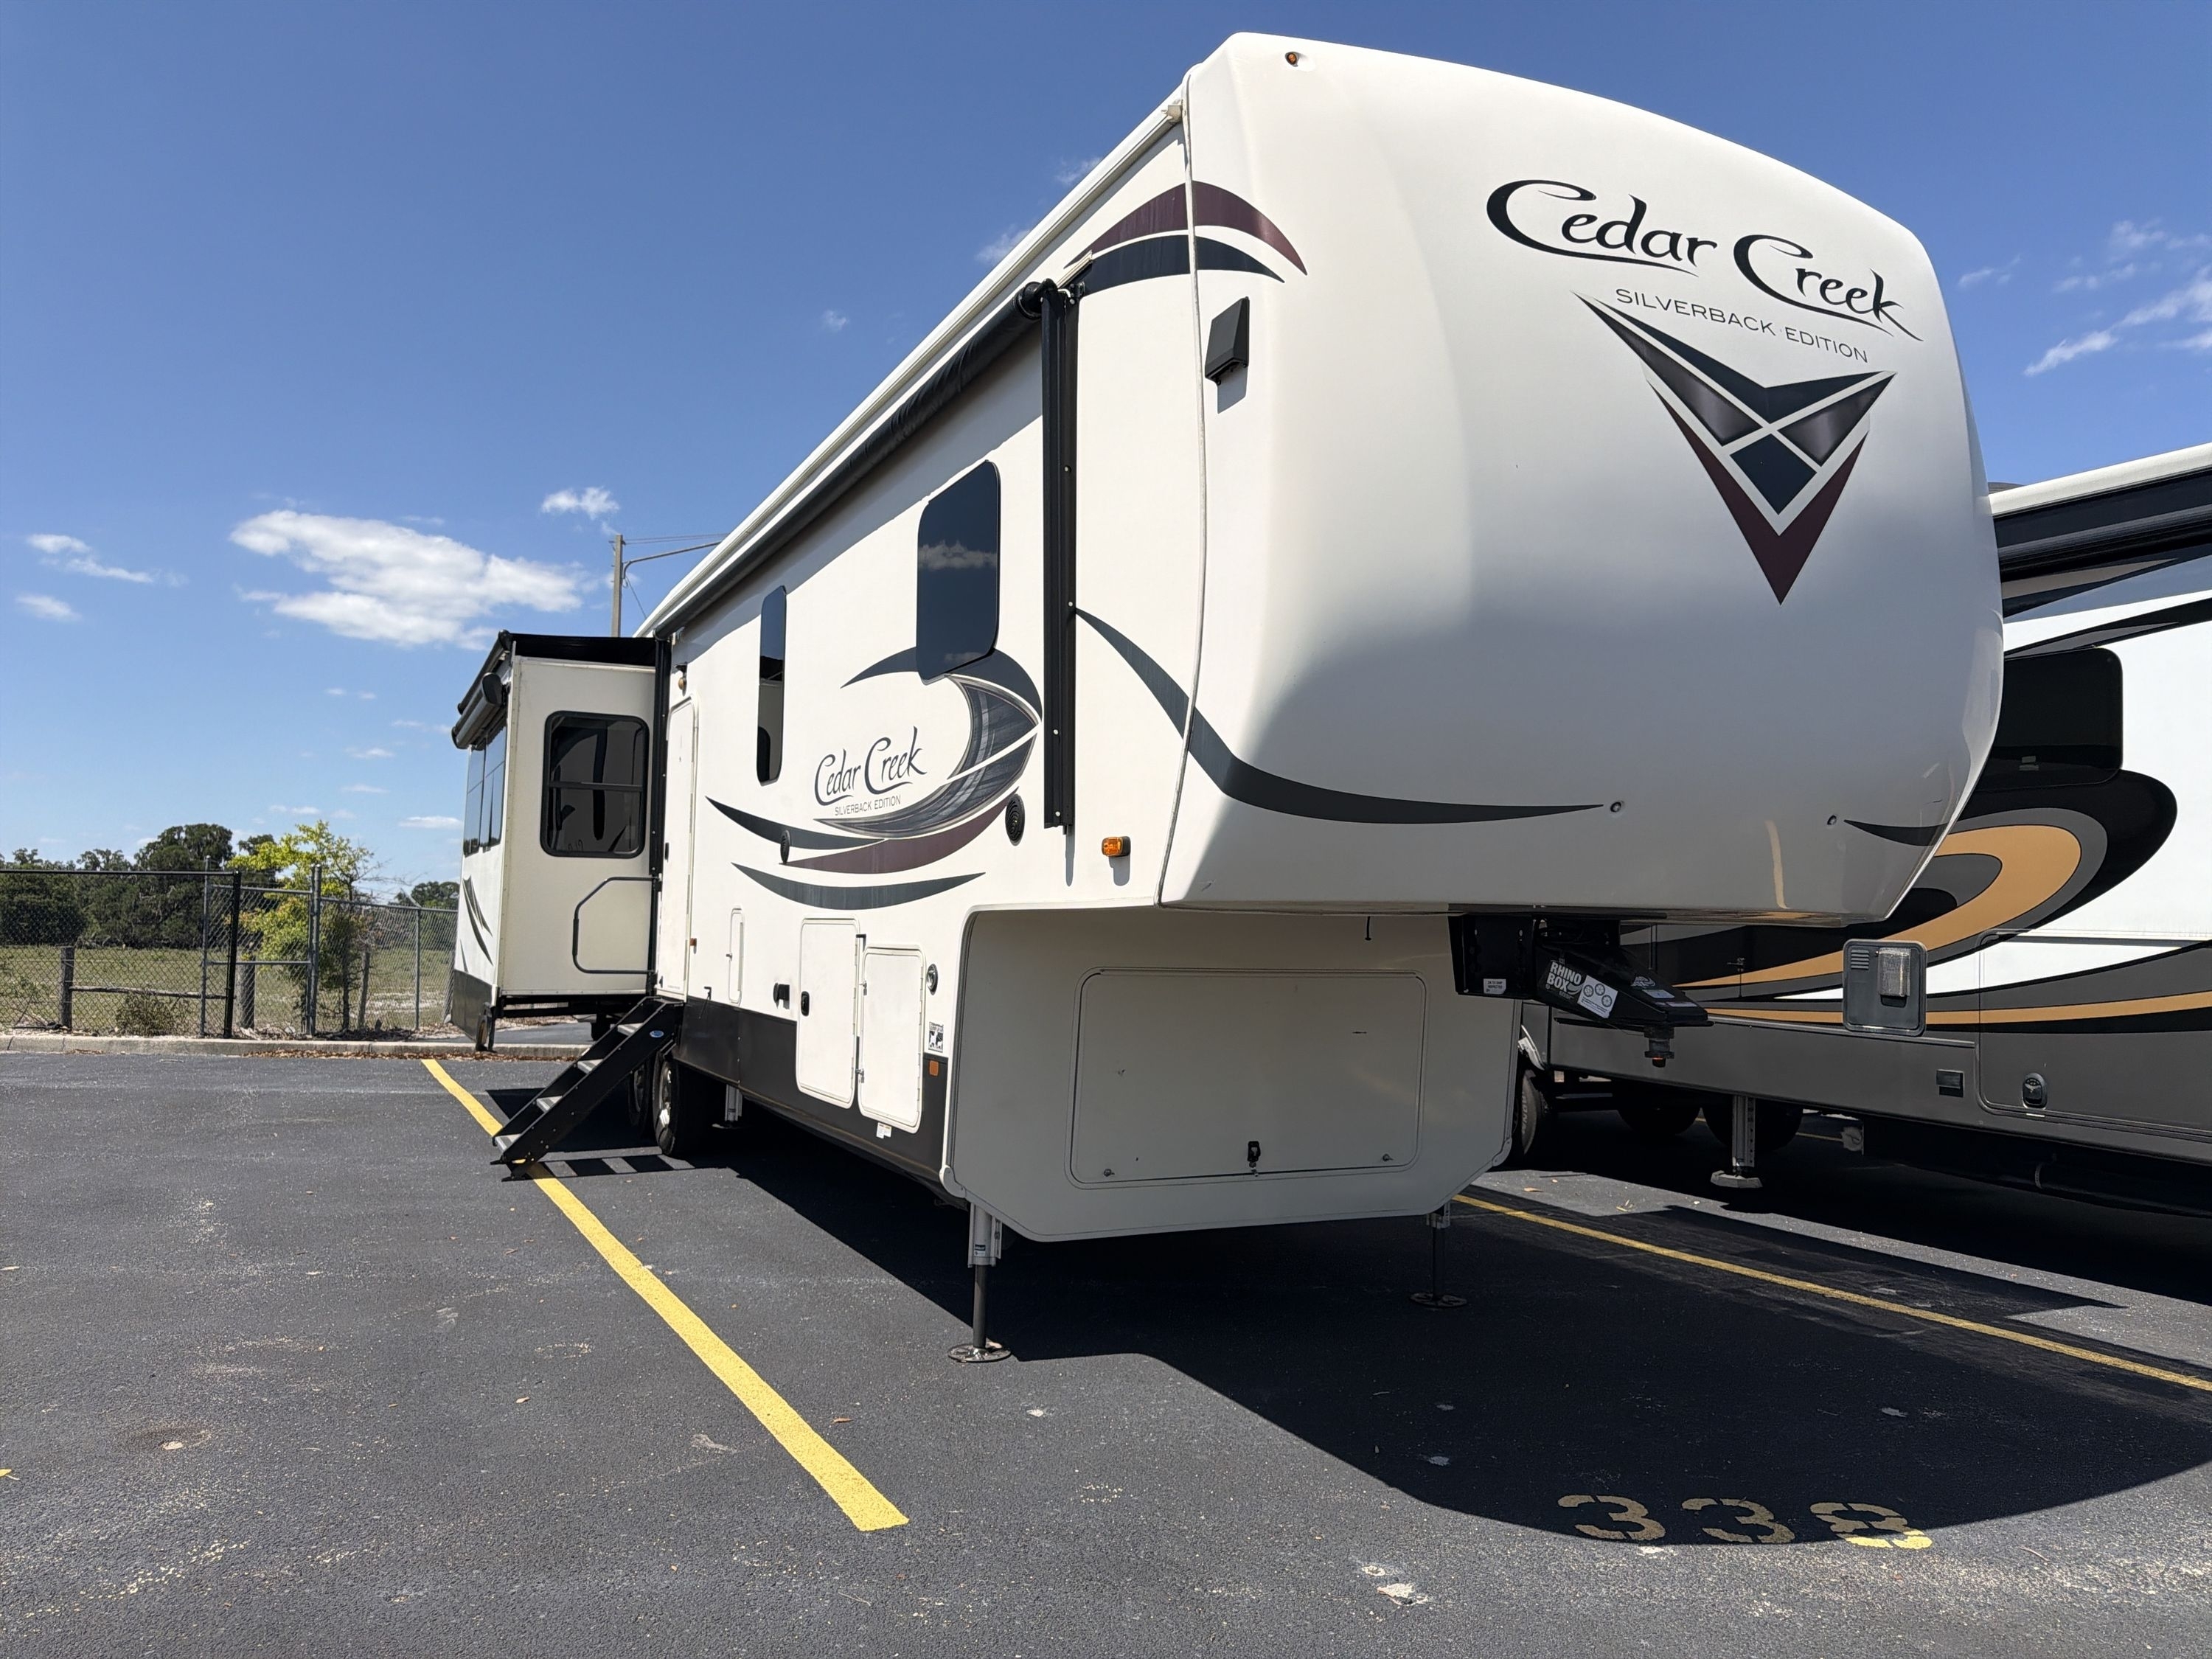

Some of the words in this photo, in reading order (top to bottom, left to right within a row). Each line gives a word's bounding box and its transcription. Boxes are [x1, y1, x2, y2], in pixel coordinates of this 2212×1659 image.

[1486, 179, 1718, 277] Cedar
[1733, 234, 1924, 342] Creek
[1615, 288, 1775, 336] SILVERBACK
[1785, 327, 1868, 364] EDITION
[814, 748, 861, 806] Cedar
[864, 725, 928, 795] Creek
[835, 801, 872, 816] SILVERBACK
[874, 794, 901, 810] EDITION
[1546, 972, 1570, 992] BOX
[1550, 961, 1582, 985] RHINO
[1557, 1495, 1933, 1550] 338
